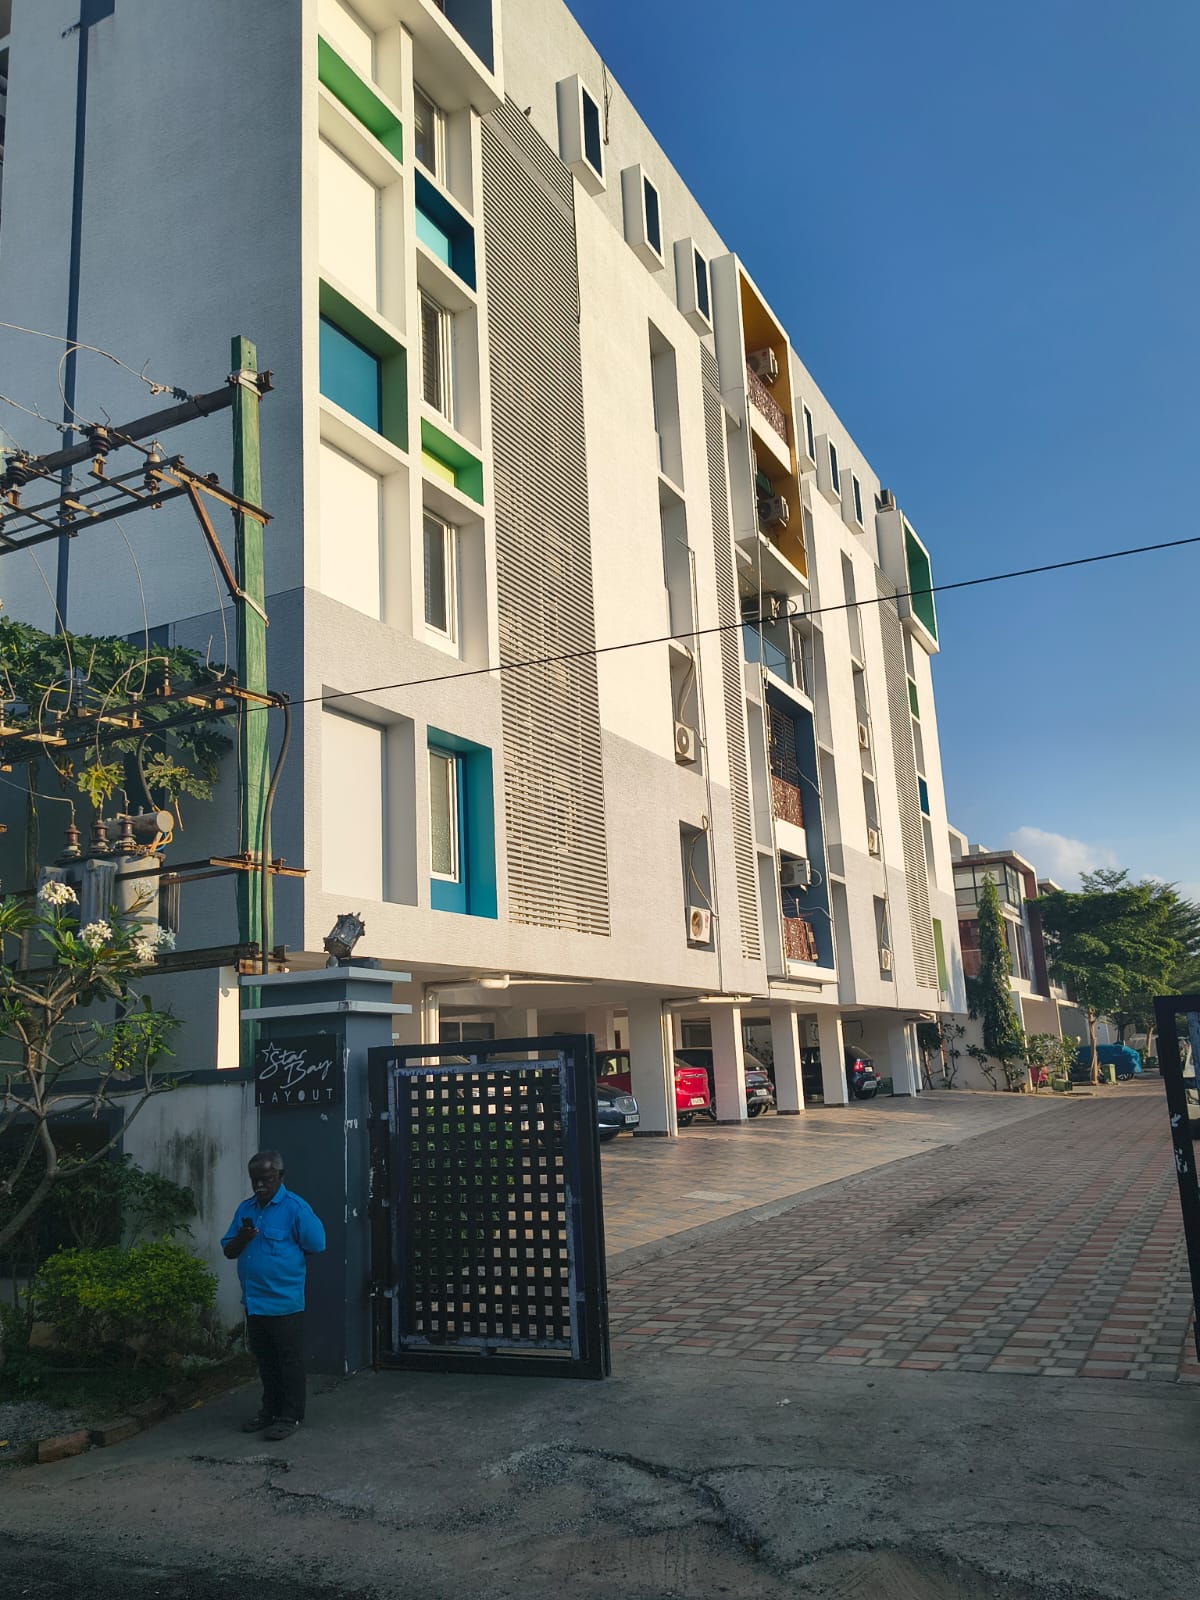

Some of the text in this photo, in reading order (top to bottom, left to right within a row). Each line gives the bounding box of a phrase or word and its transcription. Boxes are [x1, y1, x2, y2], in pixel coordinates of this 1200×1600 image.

[259, 1047, 307, 1080] Star
[280, 1060, 333, 1089] Bay
[259, 1088, 333, 1104] LAYOUT
